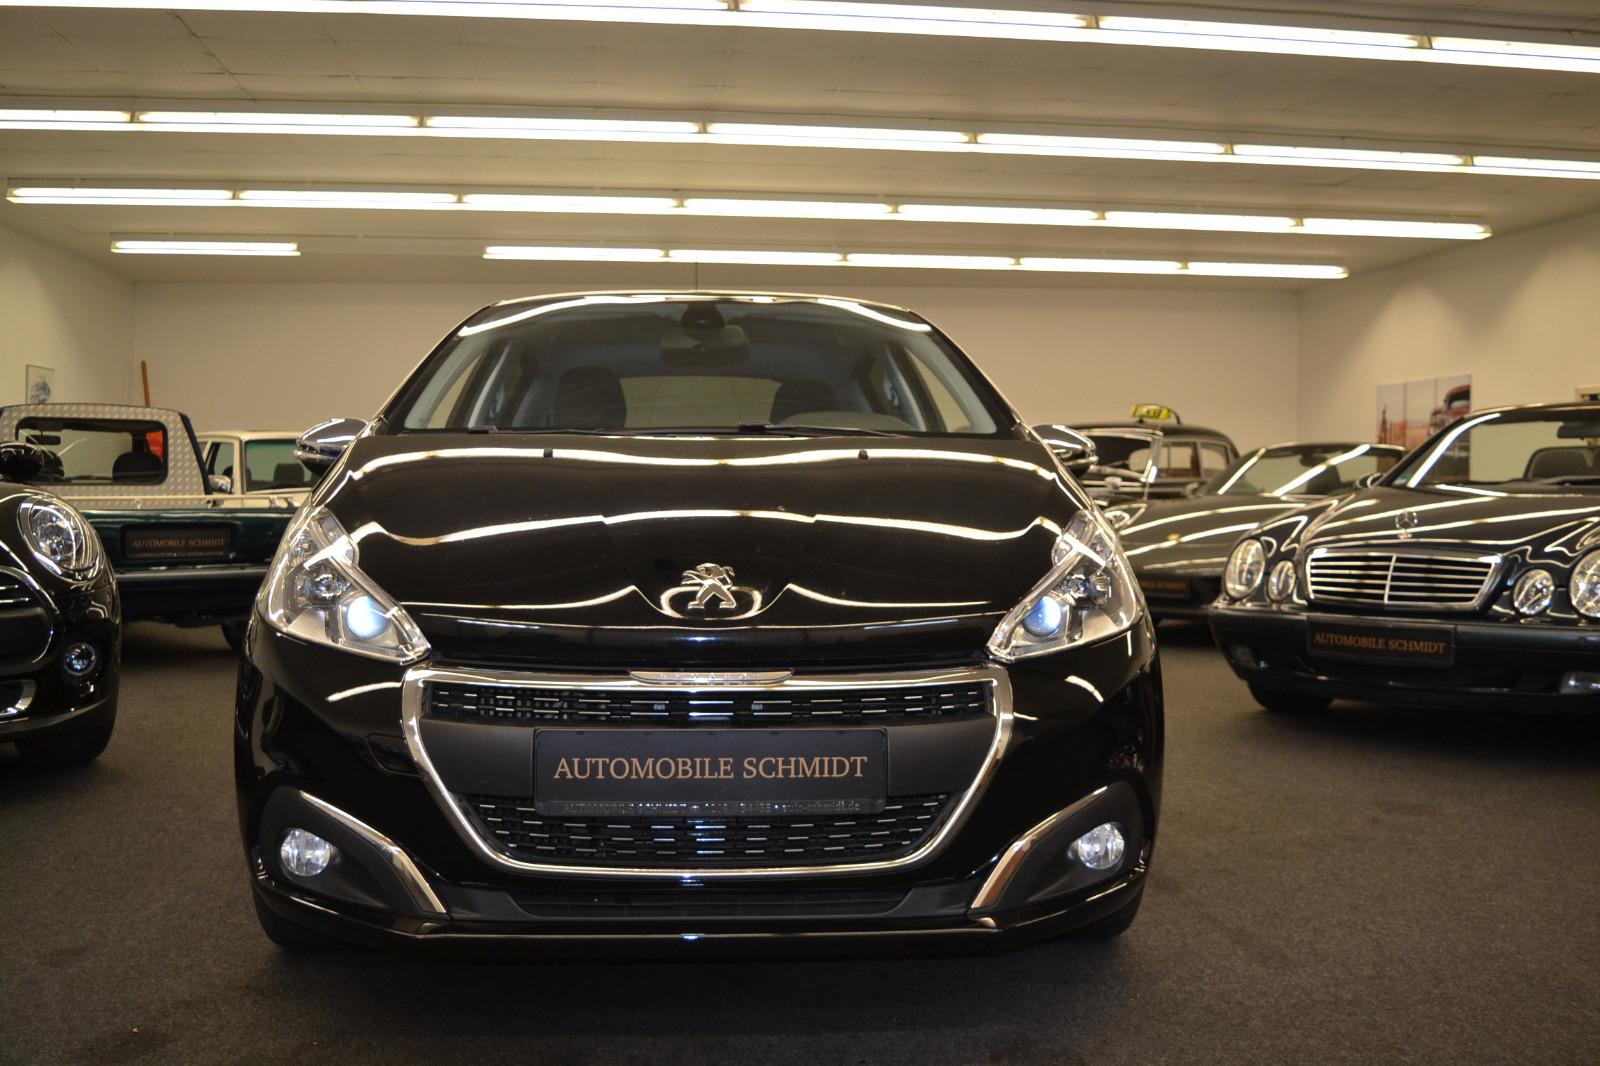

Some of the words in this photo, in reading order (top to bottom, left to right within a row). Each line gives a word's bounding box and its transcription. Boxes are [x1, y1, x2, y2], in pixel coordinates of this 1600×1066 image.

[1313, 631, 1386, 649] AUTOMOBILE
[1387, 638, 1447, 654] SCHMIDT
[552, 756, 735, 780] AUTOMOBILE
[742, 755, 868, 779] SCHMIDT
